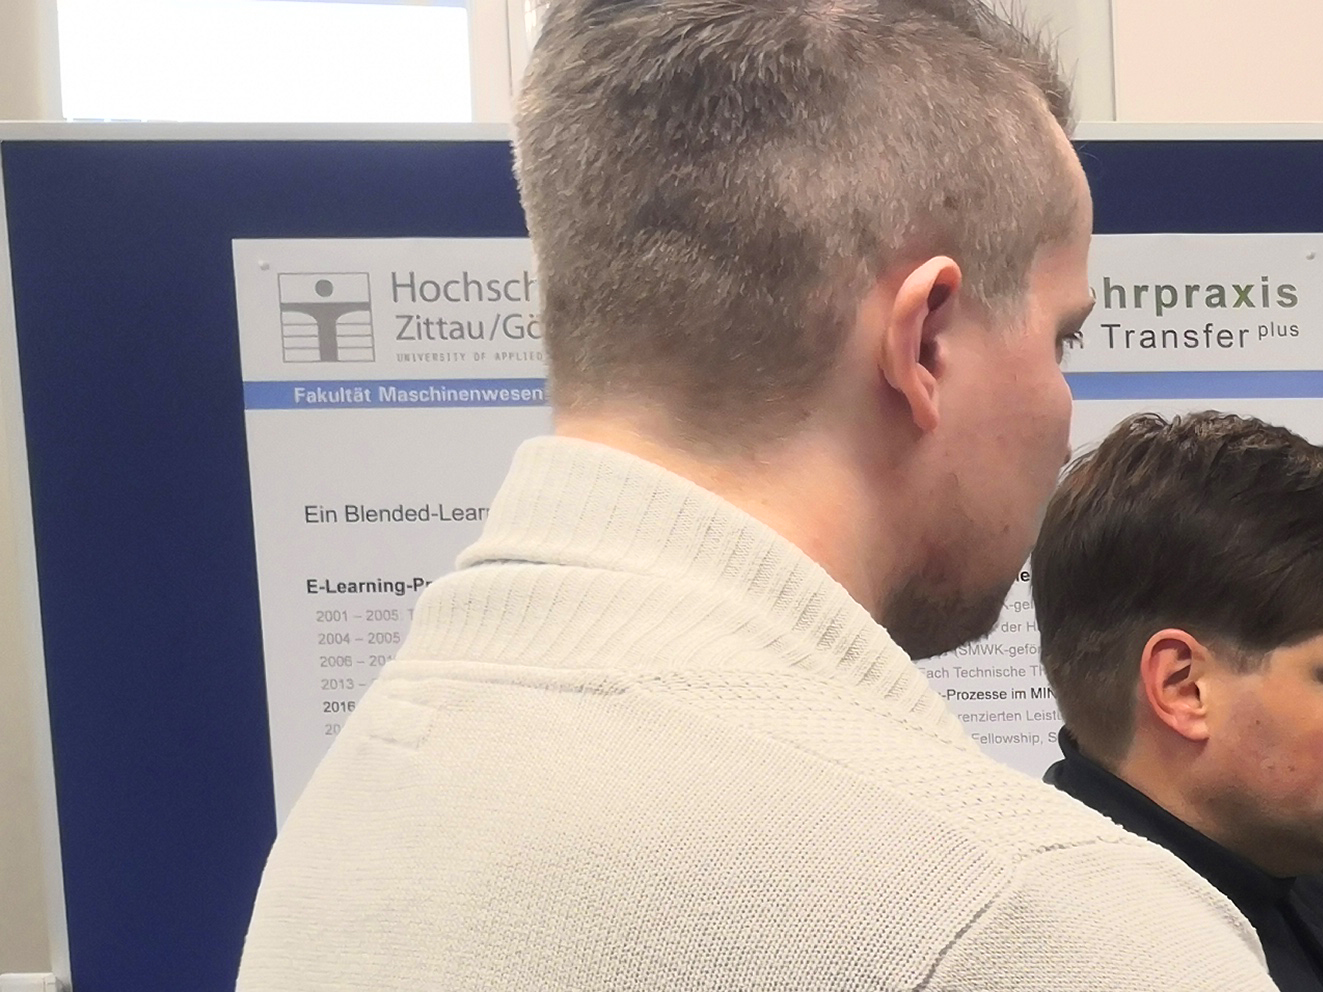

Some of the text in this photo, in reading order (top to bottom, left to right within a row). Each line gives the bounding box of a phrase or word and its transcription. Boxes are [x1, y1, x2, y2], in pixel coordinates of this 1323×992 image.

[1091, 276, 1299, 317] hrpraxis
[1100, 323, 1250, 348] Transfer
[1258, 321, 1299, 340] plus
[396, 352, 543, 362] UNIVERSITY OF APPLIED
[294, 386, 544, 404] Fakultät Maschinenwesen
[305, 505, 338, 523] Ein
[316, 609, 398, 622] 2001 2005
[1001, 622, 1022, 632] der
[318, 632, 400, 644] 2004 2005
[320, 656, 352, 667] 2006
[953, 666, 1026, 678] Technische
[321, 679, 354, 690] 2013
[938, 689, 1007, 700] -Prozesse
[1011, 688, 1027, 699] im
[323, 701, 355, 713] 2016
